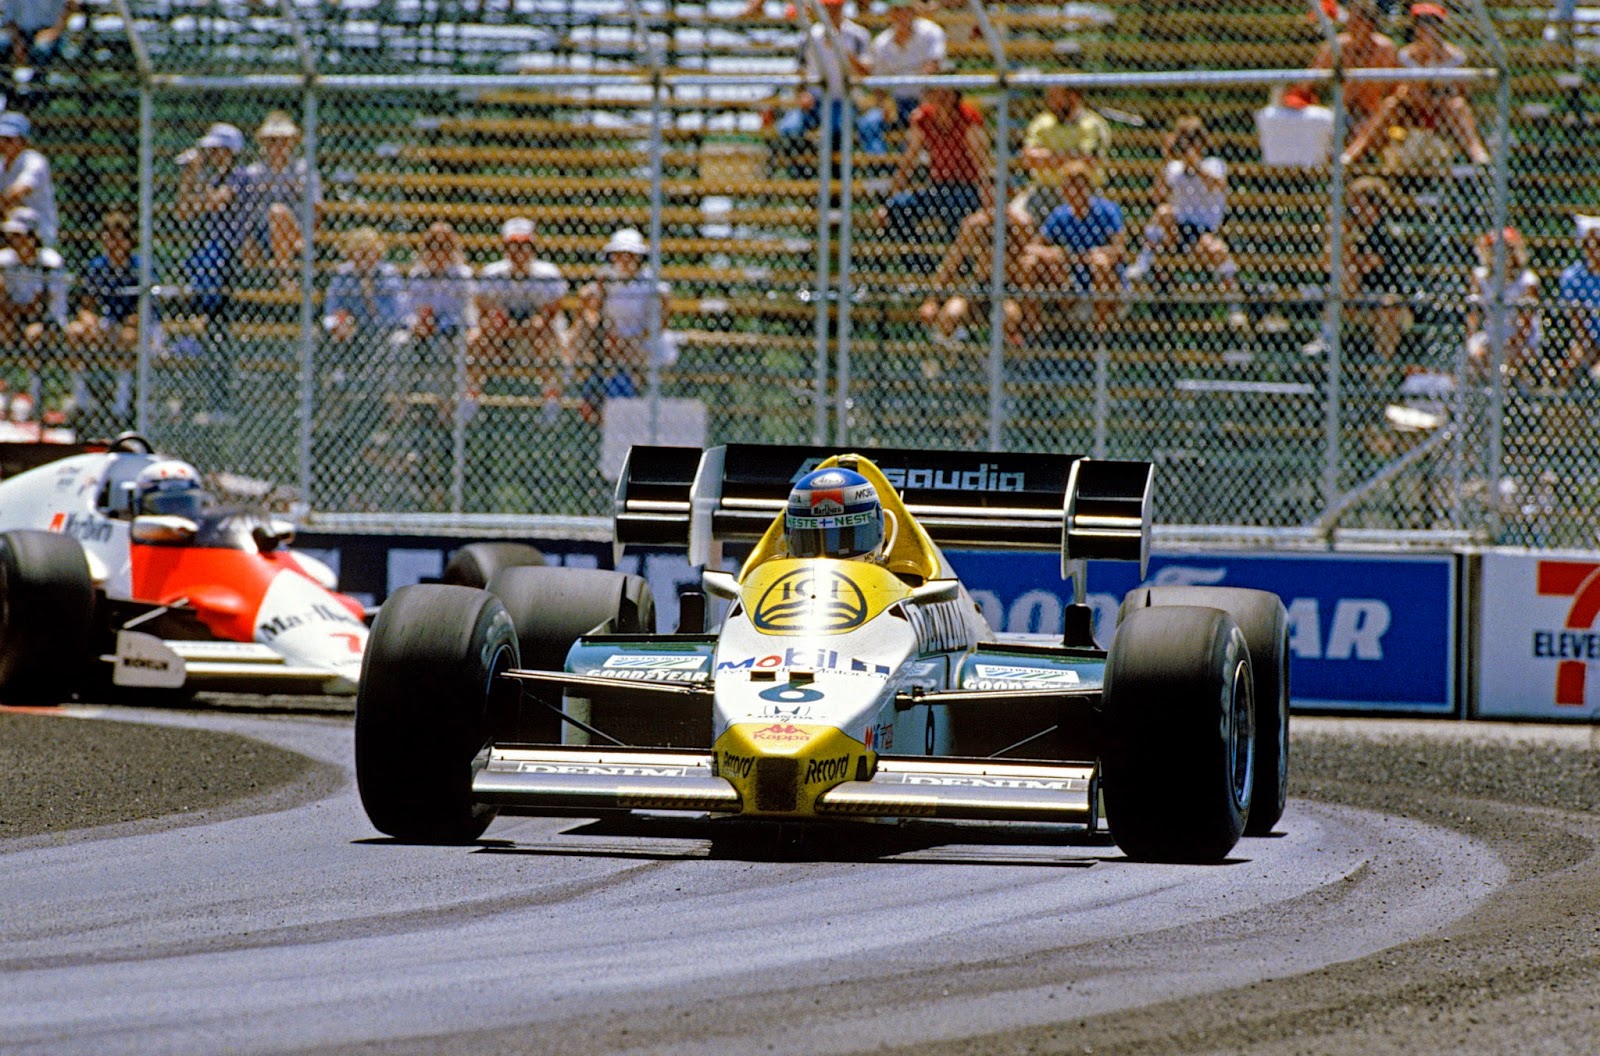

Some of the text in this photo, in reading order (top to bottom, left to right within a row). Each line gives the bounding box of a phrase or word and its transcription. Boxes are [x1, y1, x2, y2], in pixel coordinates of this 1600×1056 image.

[717, 647, 838, 672] Mobil
[759, 680, 825, 703] 6
[753, 733, 810, 742] Kappa
[523, 763, 682, 777] DENIM
[904, 775, 1069, 790] DENIM
